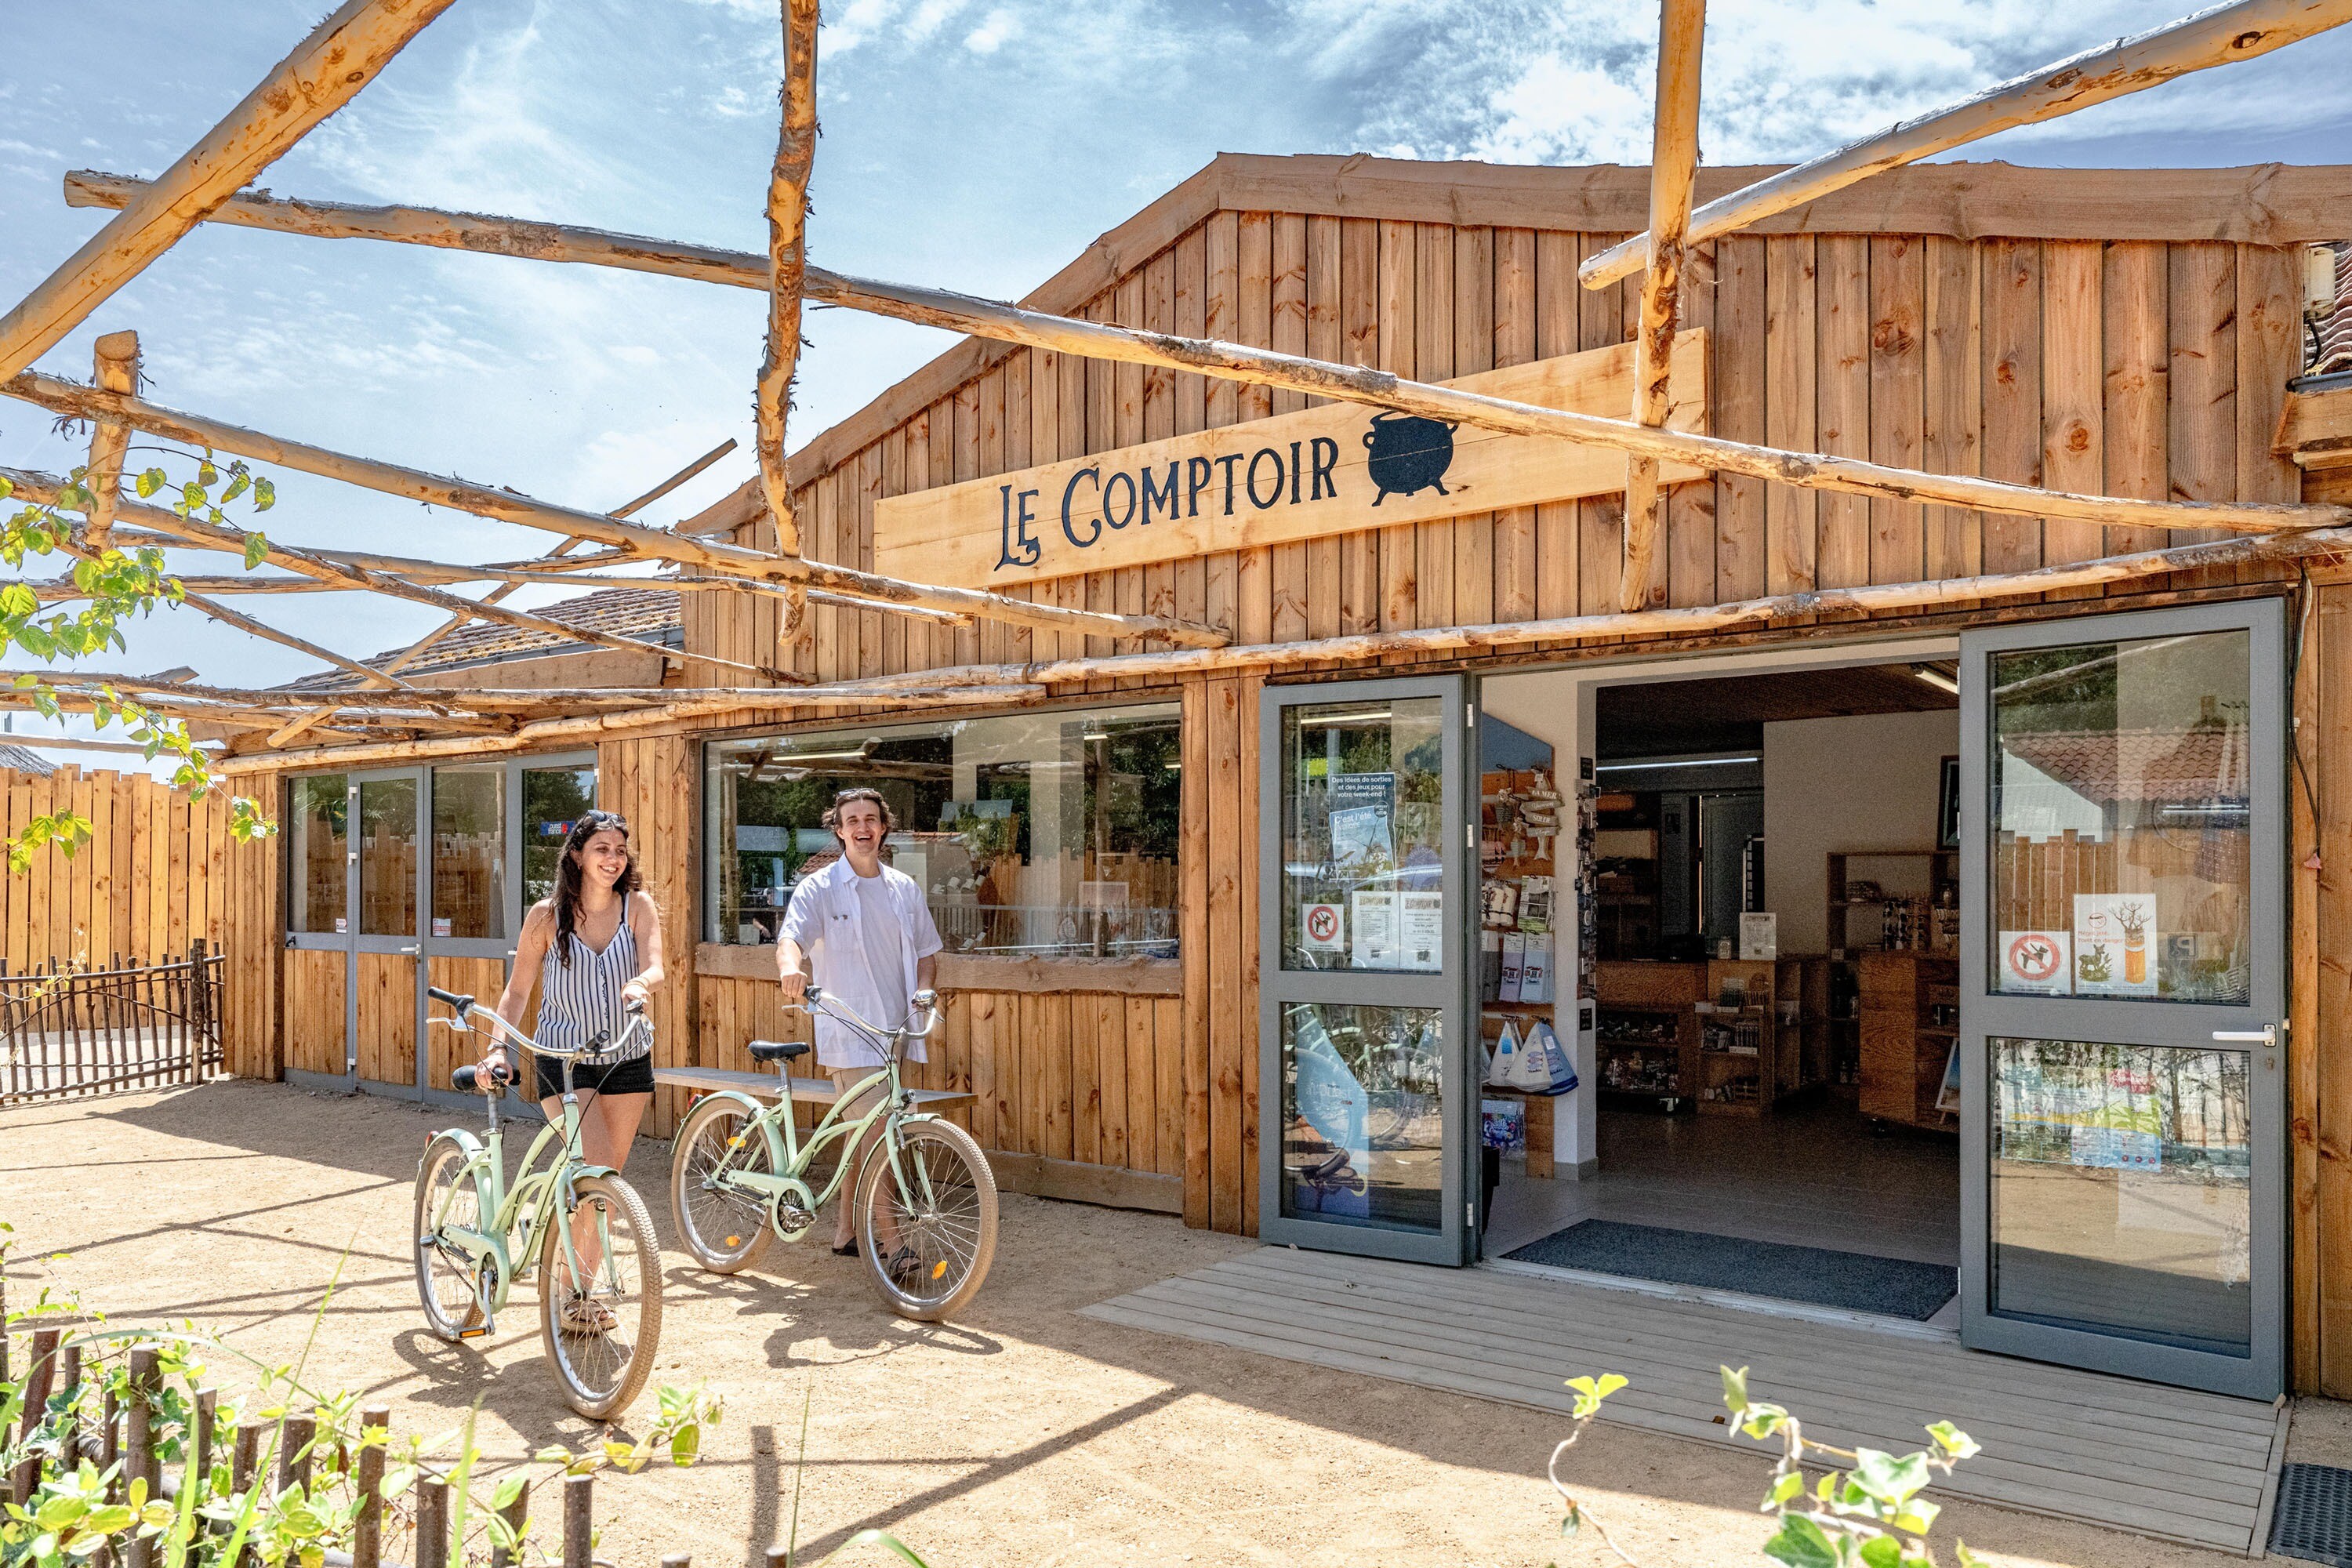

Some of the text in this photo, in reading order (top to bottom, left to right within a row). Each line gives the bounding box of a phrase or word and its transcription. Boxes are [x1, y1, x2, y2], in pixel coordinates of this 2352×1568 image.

[994, 437, 1339, 572] LE COMPTOIR
[1541, 790, 1557, 800] MER
[1355, 811, 1372, 820] l'été
